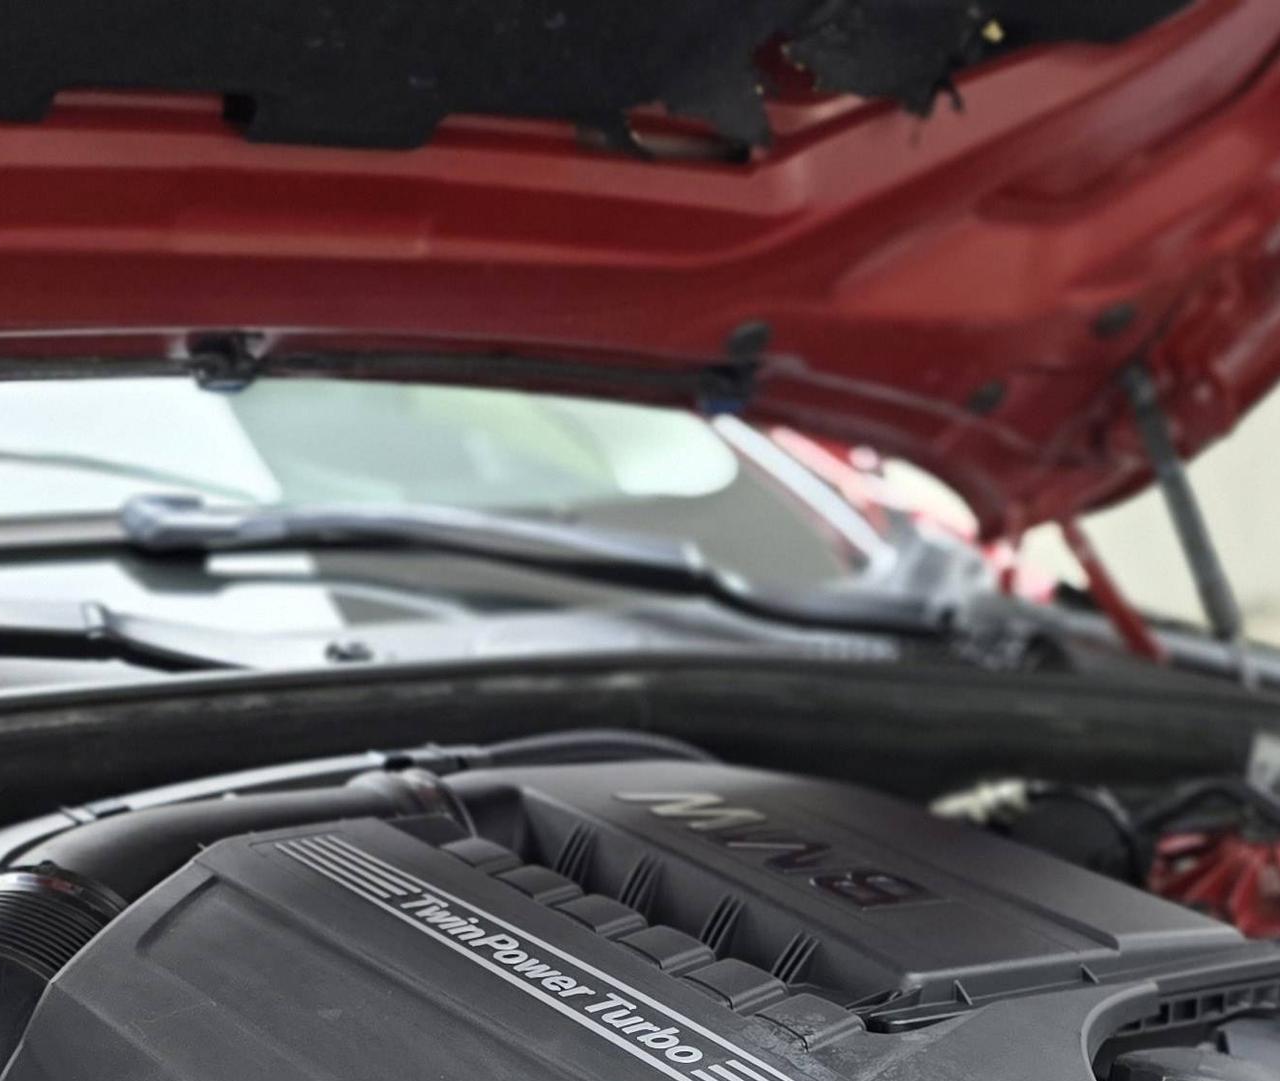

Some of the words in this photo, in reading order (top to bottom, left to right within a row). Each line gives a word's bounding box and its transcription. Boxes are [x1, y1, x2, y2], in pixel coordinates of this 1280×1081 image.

[612, 791, 928, 909] BMW
[400, 893, 596, 998] TwinPower
[584, 992, 704, 1064] Turbo
